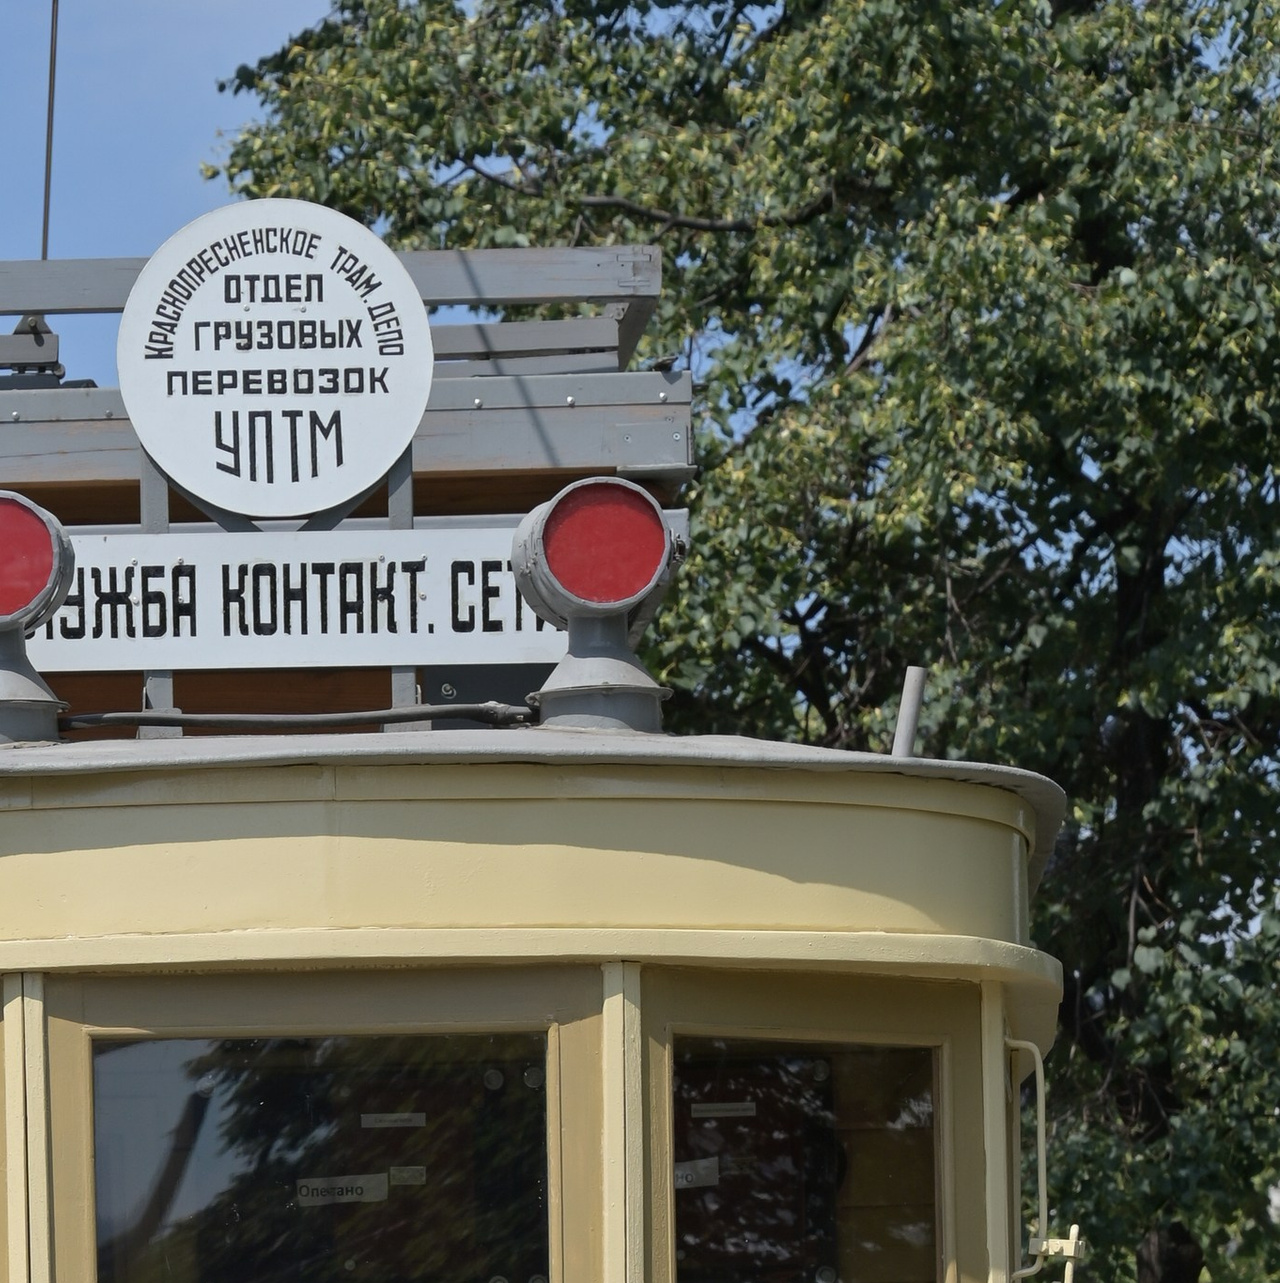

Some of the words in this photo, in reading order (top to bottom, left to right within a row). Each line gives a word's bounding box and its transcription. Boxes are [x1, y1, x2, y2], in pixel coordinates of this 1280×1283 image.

[145, 227, 322, 359] КРАСНОПРЕСНЕНСКОЕ
[330, 245, 382, 304] ТРАМ.
[367, 301, 405, 356] ДЕПО
[224, 274, 324, 303] ОТДЕЛ
[194, 319, 363, 351] ГРУЗОВЫХ
[167, 367, 390, 397] ПЕРЕВОЗОК
[215, 410, 343, 484] УПТМ
[25, 564, 197, 640] УЖБА
[221, 559, 435, 637] КОНТАКТ.
